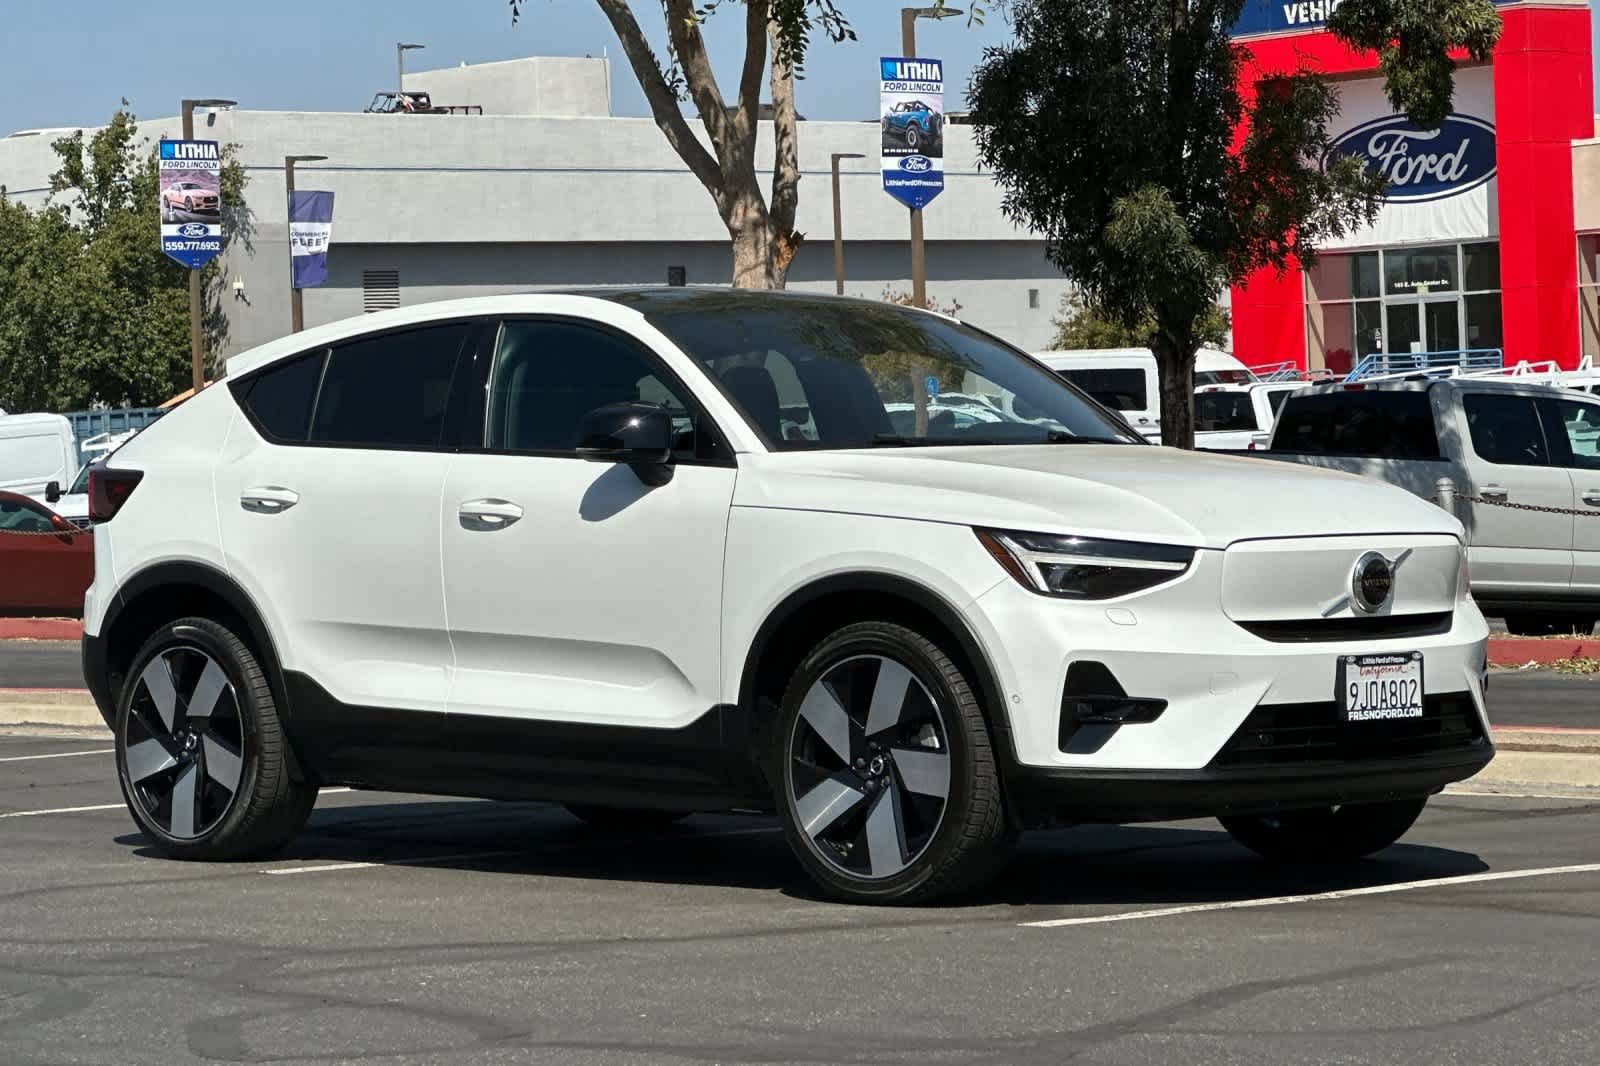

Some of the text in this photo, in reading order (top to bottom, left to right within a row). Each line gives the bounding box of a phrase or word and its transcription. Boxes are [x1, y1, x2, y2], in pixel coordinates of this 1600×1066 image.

[896, 62, 941, 80] LITHIA
[884, 82, 941, 92] FORD LINCOLN
[174, 144, 218, 159] LITHIA
[1367, 128, 1470, 186] Ford
[163, 160, 218, 169] FORD LINCOLN
[906, 157, 928, 170] Ford
[184, 224, 205, 236] Ford
[165, 241, 220, 251] 559.777.6952
[292, 237, 328, 247] FLEET
[1348, 706, 1423, 721] FRESNOFORD.COM
